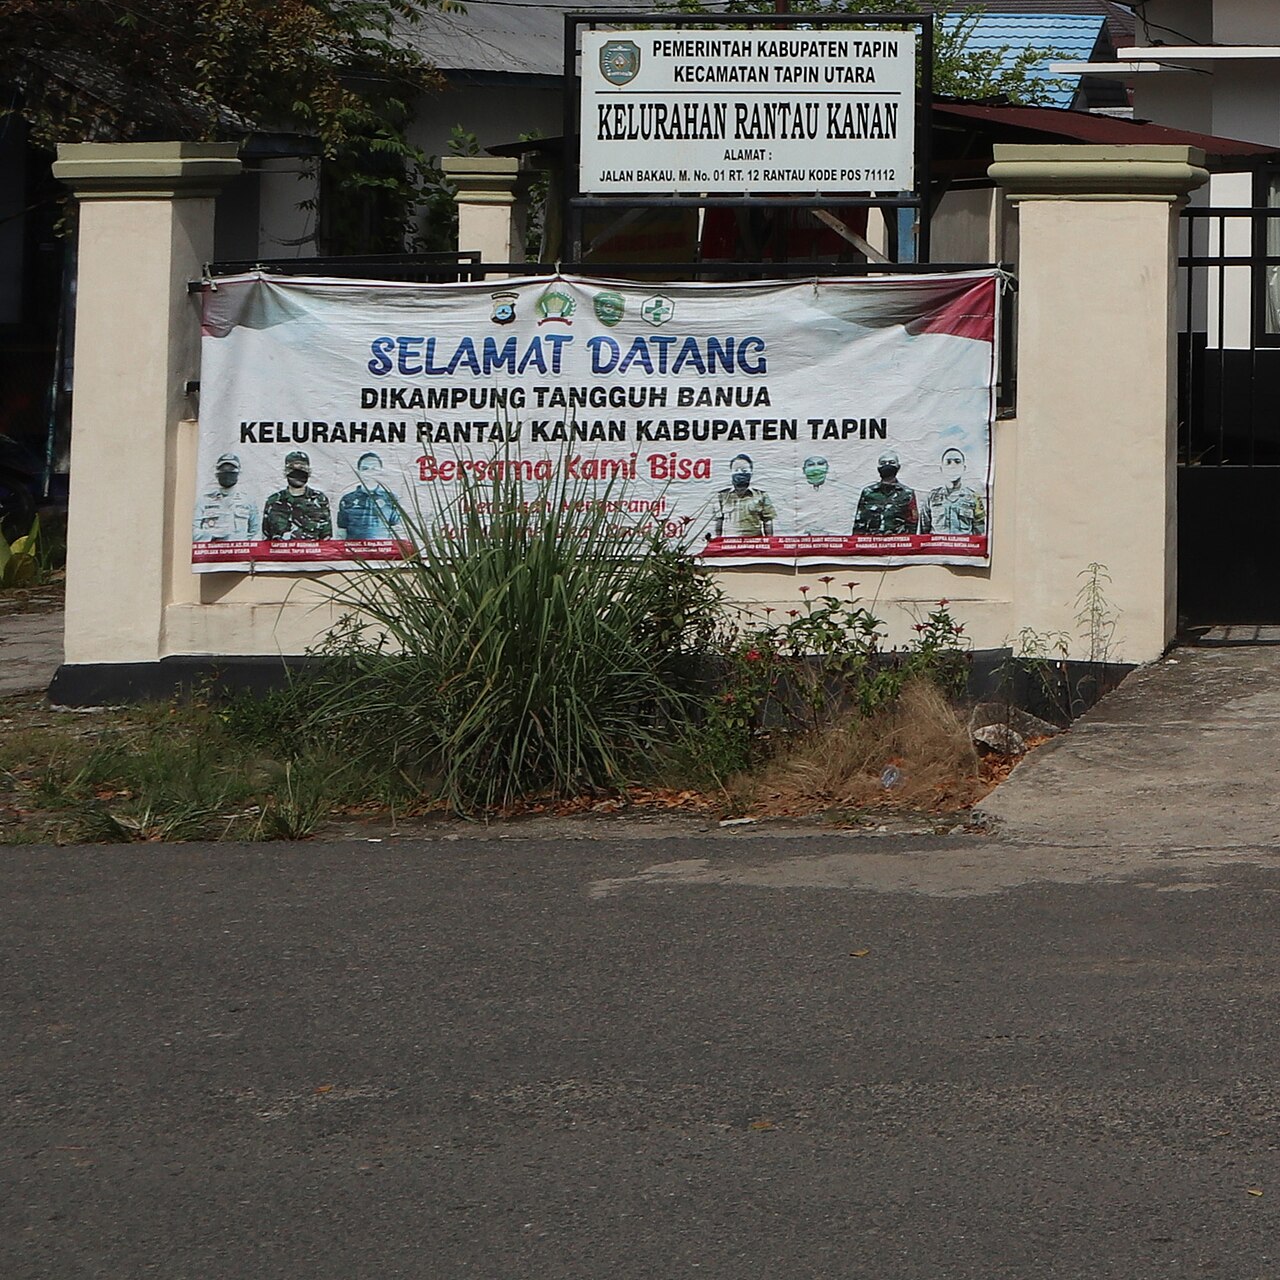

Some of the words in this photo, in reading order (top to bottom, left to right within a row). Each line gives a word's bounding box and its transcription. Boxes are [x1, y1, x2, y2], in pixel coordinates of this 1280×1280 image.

[652, 40, 752, 58] PEMERINTAH
[757, 40, 848, 58] KABUPATEN
[853, 41, 899, 58] TAPIN
[674, 65, 769, 83] KECAMATAN
[773, 66, 819, 83] TAPIN
[824, 66, 876, 84] UTARA
[597, 102, 728, 141] KELURAHAN
[734, 102, 820, 140] RANTAU
[826, 102, 899, 140] KANAN
[723, 148, 766, 161] ALAMAT
[599, 170, 634, 182] JALAN
[636, 170, 676, 182] BAKAU.
[678, 169, 691, 182] M.
[693, 169, 711, 182] No.
[713, 169, 725, 182] 01
[728, 169, 744, 181] RT.
[747, 169, 760, 181] 12
[763, 169, 806, 181] RANTAU
[808, 169, 838, 181] KODE
[840, 169, 862, 181] POS
[864, 168, 895, 181] 71112
[367, 332, 575, 377] SELAMAT
[586, 333, 769, 377] DATANG
[360, 387, 526, 410] DIKAMPUNG
[533, 386, 667, 409] TANGGUH
[677, 386, 771, 408] BANUA
[240, 421, 406, 444] KELURAHAN
[416, 420, 523, 444] RANTAU
[531, 420, 626, 443] KANAN
[636, 419, 798, 442] KABUPATEN
[807, 418, 887, 440] TAPIN
[416, 455, 552, 482] Bersama
[564, 452, 637, 480] Kami
[646, 451, 712, 481] Bisa
